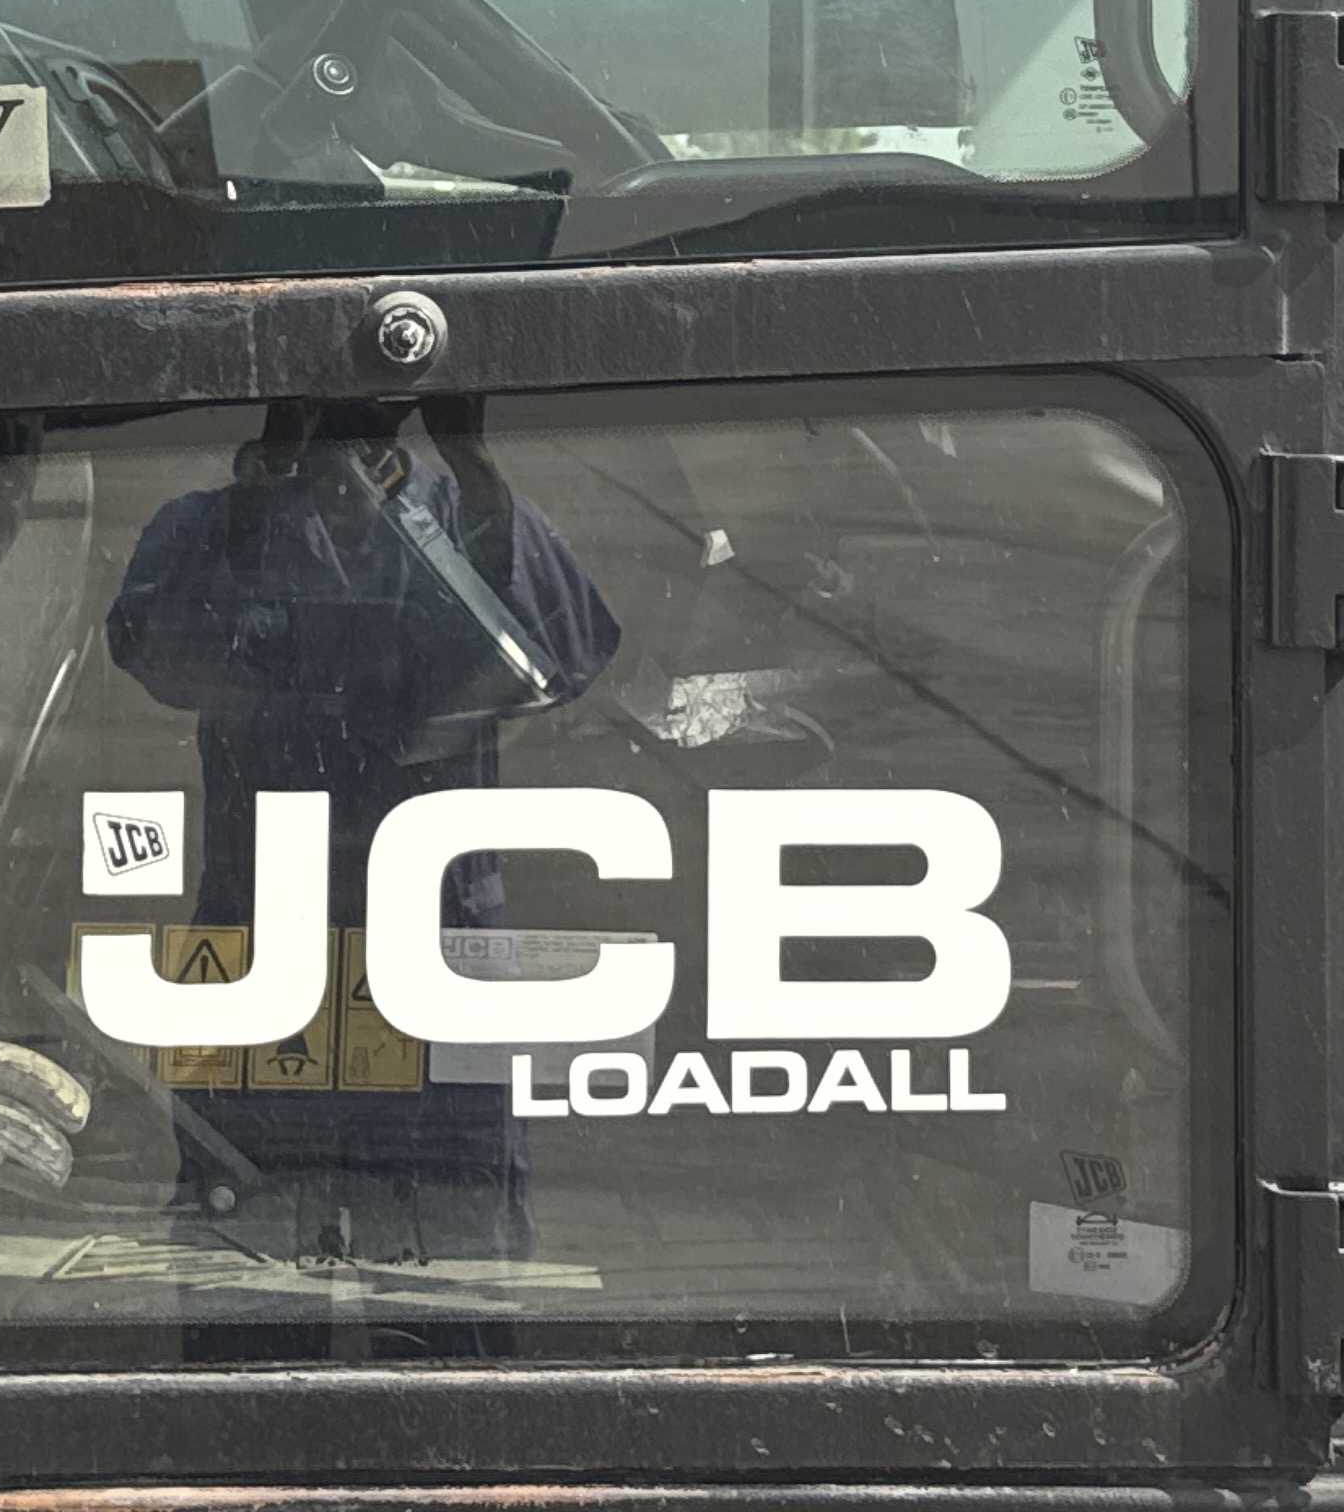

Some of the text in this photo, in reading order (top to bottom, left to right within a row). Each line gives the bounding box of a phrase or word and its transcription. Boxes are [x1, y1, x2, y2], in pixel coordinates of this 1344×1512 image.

[107, 820, 164, 868] JCB
[81, 788, 1012, 1046] JCB
[443, 937, 511, 959] JCB
[512, 1049, 1007, 1117] LOADALL
[1073, 1157, 1122, 1197] JCB
